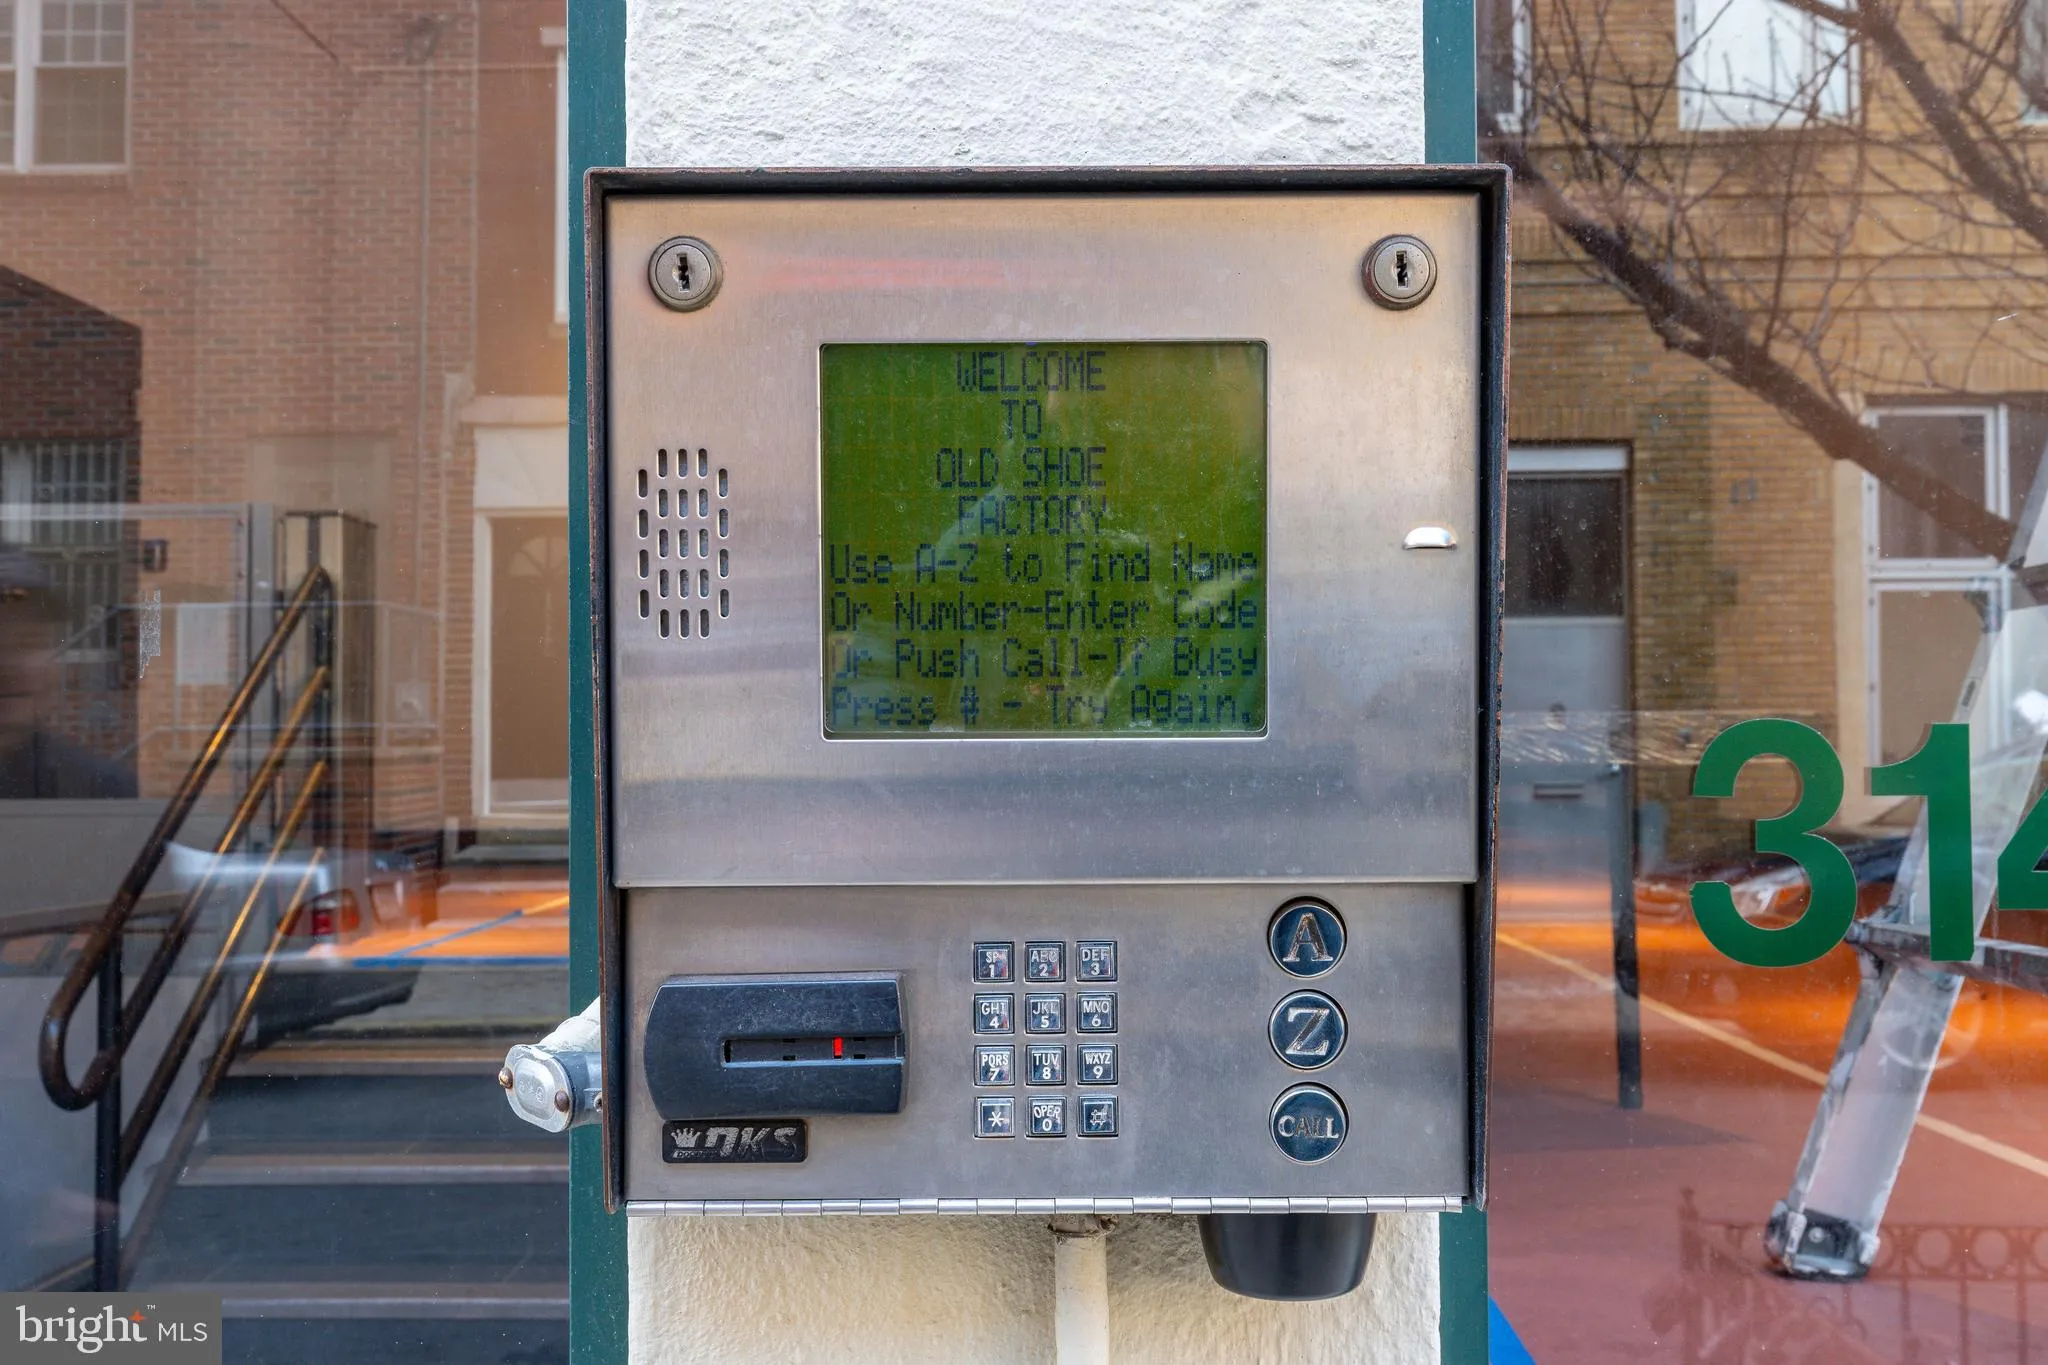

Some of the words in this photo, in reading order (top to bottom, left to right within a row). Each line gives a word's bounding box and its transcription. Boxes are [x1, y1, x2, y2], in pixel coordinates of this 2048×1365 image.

[957, 351, 1106, 391] WELCOME
[1001, 400, 1042, 439] TO
[936, 447, 1000, 487] OLD
[1022, 447, 1107, 487] SHOE
[958, 495, 1107, 535] FACTORY
[830, 544, 893, 583] Use
[916, 544, 979, 582] A-Z
[1004, 545, 1042, 582] to
[1065, 543, 1150, 582] Find
[1173, 542, 1258, 580] Name
[830, 592, 873, 631] Or
[1173, 590, 1258, 628] Code
[895, 639, 980, 678] Push
[1173, 637, 1258, 676] Busy
[831, 687, 937, 725] Press
[960, 686, 980, 725] #
[1045, 685, 1108, 724] Try
[1131, 684, 1252, 724] Again.
[1282, 912, 1334, 962] A
[1082, 949, 1108, 961] DEF
[989, 964, 995, 978] 1
[1039, 964, 1048, 976] 2
[1091, 963, 1100, 976] 3
[981, 1001, 1007, 1015] GHI
[1032, 1001, 1057, 1015] JKL
[1083, 1001, 1110, 1014] MNO
[989, 1016, 999, 1028] 4
[1040, 1016, 1049, 1028] 5
[1091, 1014, 1101, 1027] 6
[1286, 1007, 1330, 1056] Z
[981, 1053, 1009, 1067] PQRS
[1033, 1053, 1060, 1067] TUV
[1085, 1052, 1111, 1065] WXYZ
[989, 1068, 999, 1081] 7
[1042, 1067, 1051, 1080] 8
[1092, 1065, 1103, 1079] 9
[1277, 1115, 1339, 1139] CALL
